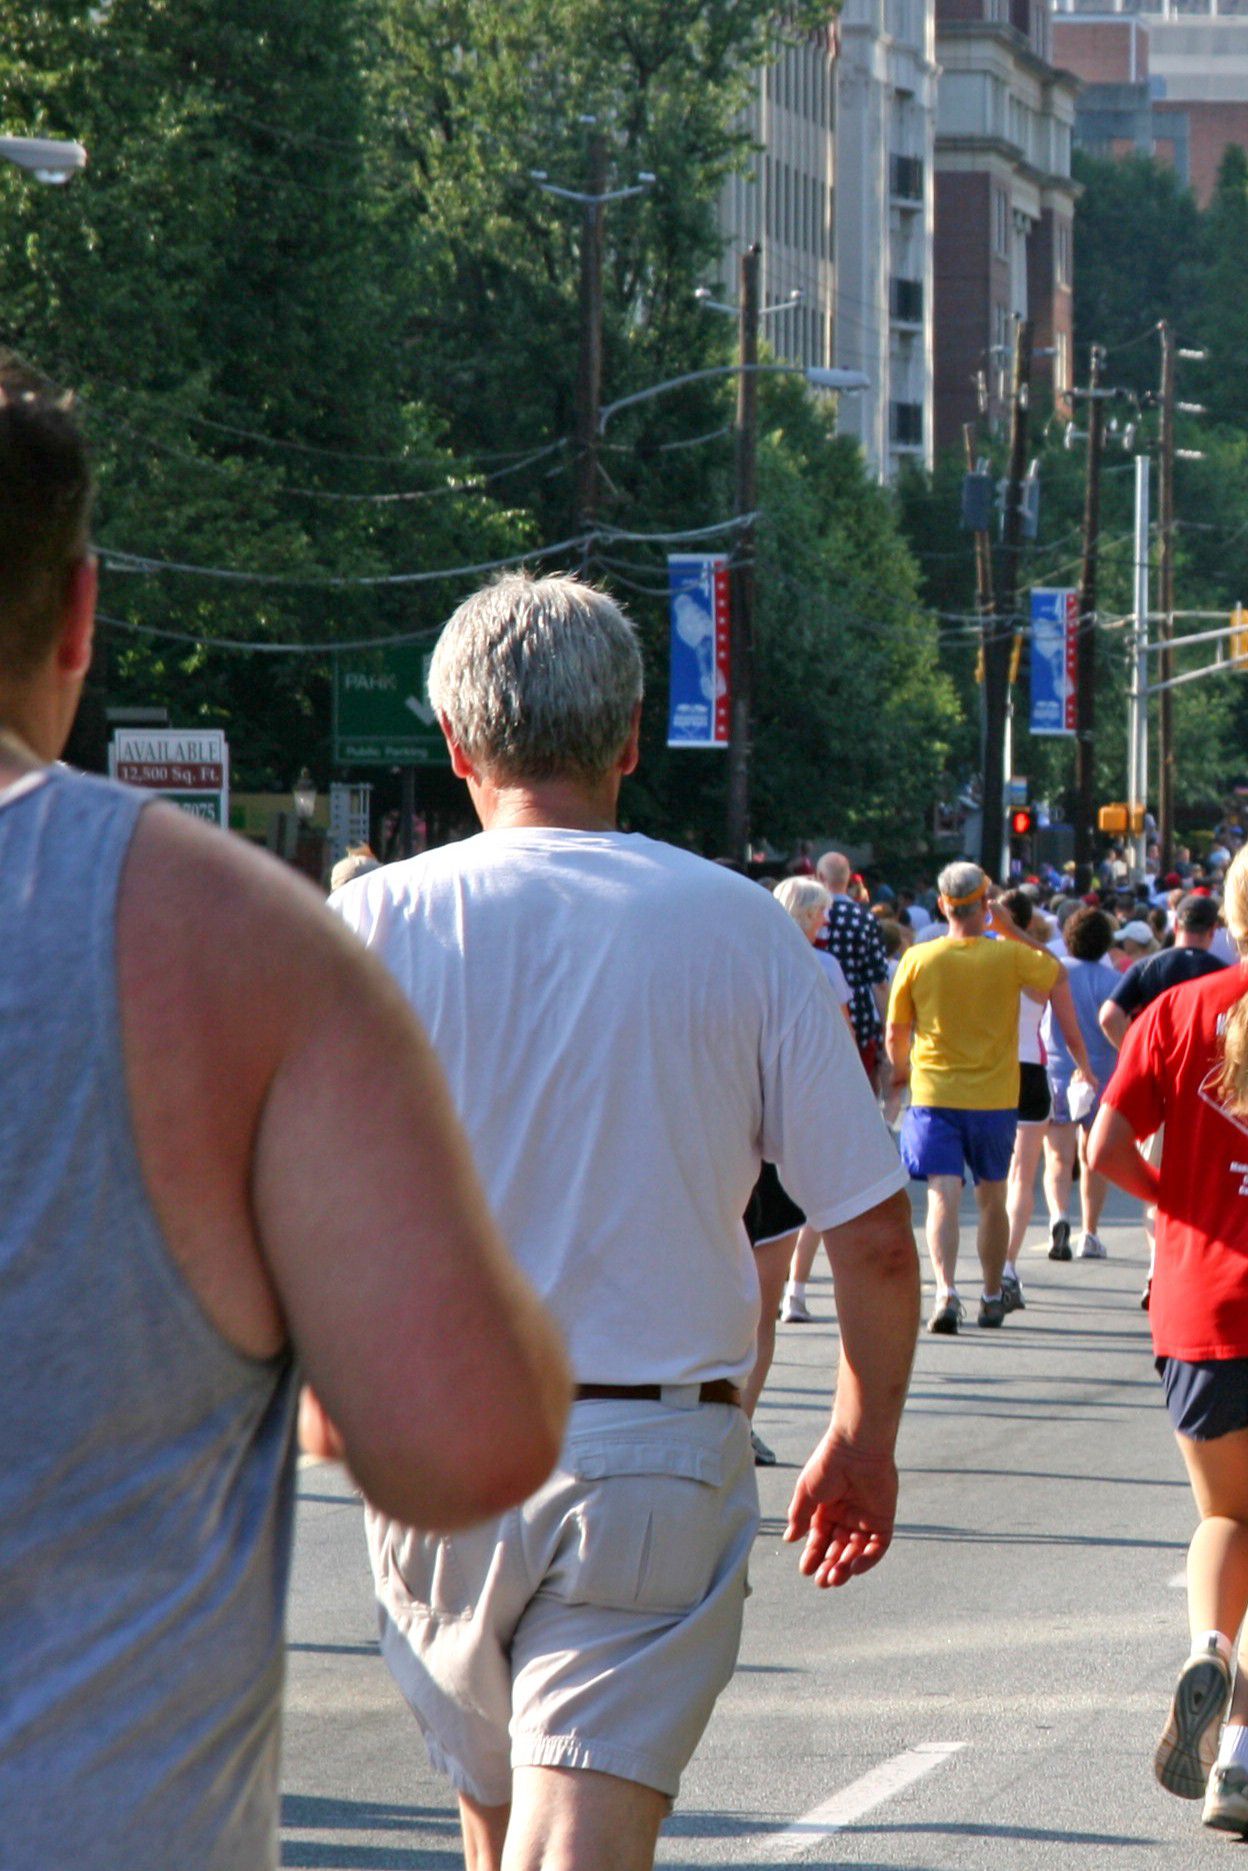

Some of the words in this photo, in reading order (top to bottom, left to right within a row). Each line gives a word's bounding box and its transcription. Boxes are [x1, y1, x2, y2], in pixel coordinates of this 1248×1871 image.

[123, 740, 218, 761] AVAILABLE
[123, 766, 169, 782] 12,500
[171, 766, 197, 785] Sq.
[201, 766, 220, 780] Ft.
